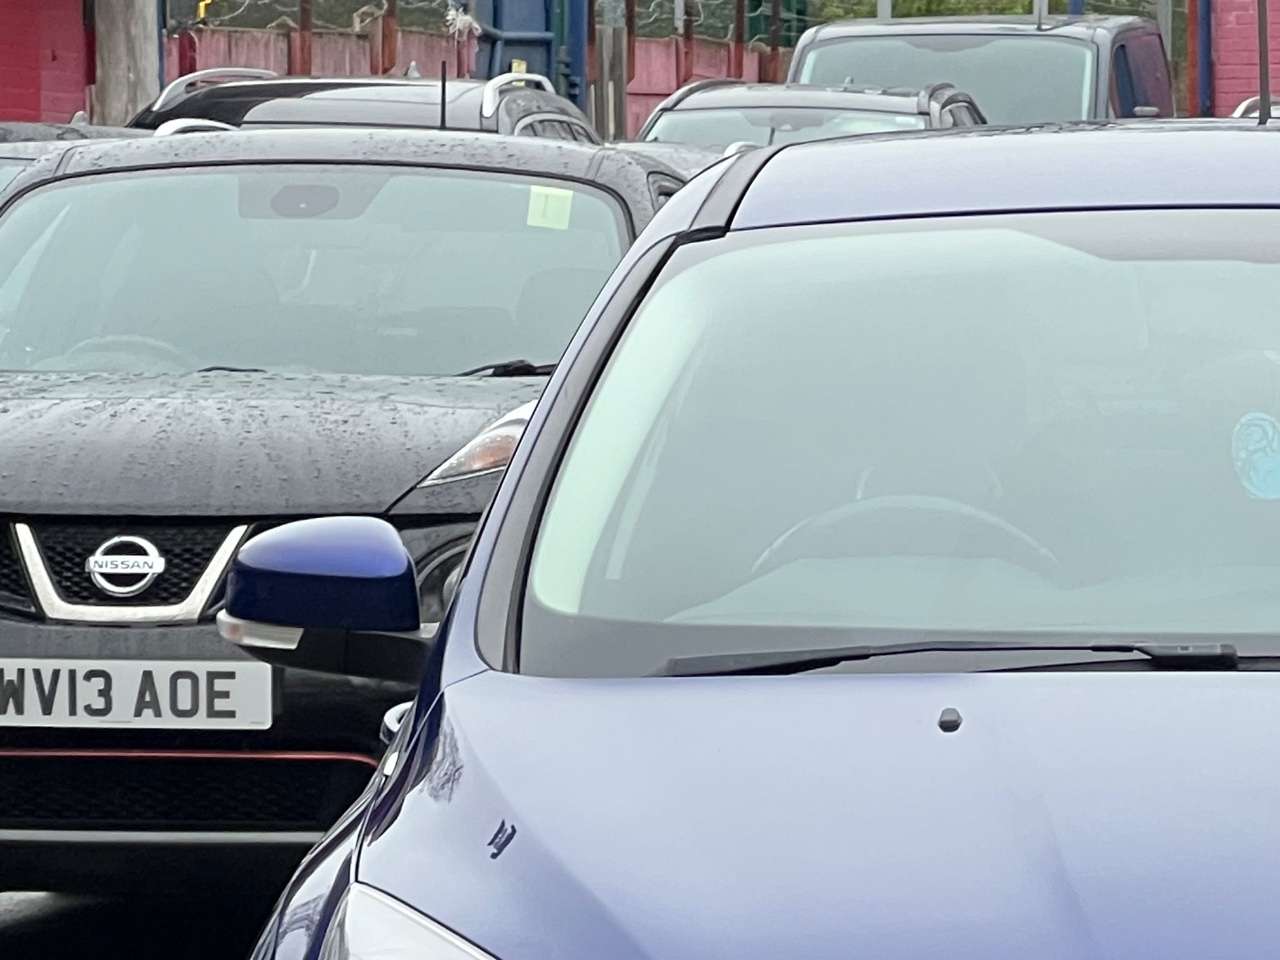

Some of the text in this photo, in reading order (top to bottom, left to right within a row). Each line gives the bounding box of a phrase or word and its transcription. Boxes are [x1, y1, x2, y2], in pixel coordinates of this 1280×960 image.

[92, 560, 155, 570] NISSAN
[0, 668, 237, 719] WV13 AOE
